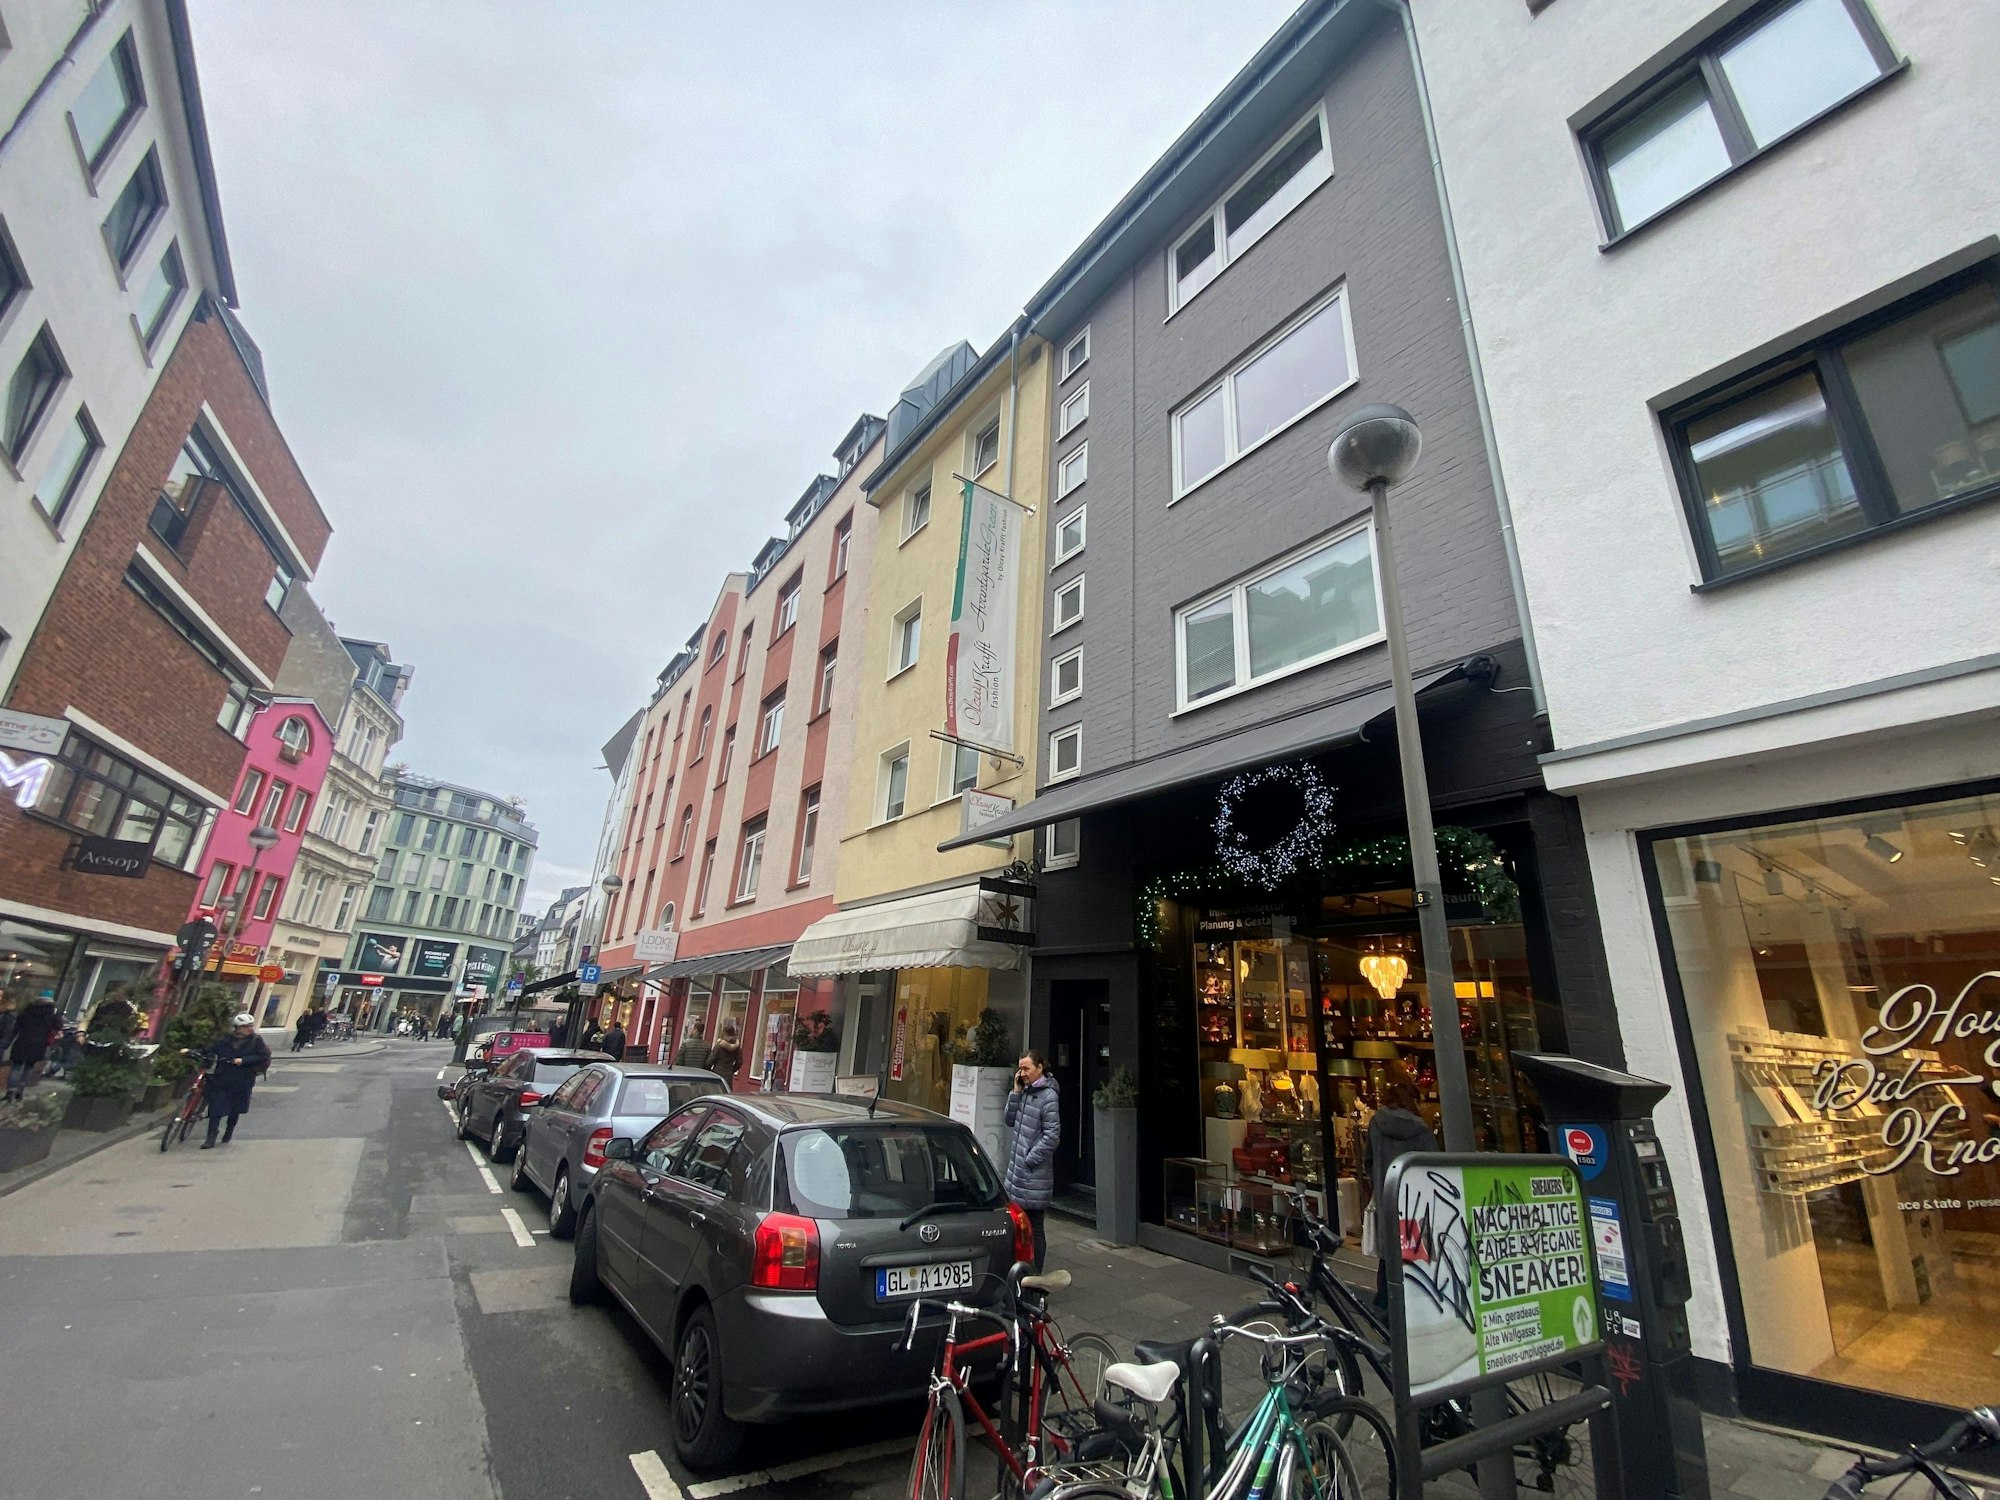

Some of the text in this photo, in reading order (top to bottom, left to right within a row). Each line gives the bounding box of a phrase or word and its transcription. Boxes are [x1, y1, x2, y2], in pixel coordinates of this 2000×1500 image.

[999, 533, 1007, 552] Krafft
[998, 553, 1006, 572] Olcay
[990, 677, 999, 709] fashion
[80, 852, 140, 872] Aesop
[1416, 892, 1424, 903] 6
[1200, 915, 1298, 931] Planung & Gestag
[1811, 1058, 1985, 1110] Did
[1578, 1156, 1596, 1164] 1503
[1532, 1178, 1563, 1196] SNEAKERS
[1897, 1201, 1921, 1211] ace
[1922, 1200, 1933, 1210] &
[1933, 1198, 1962, 1210] tate
[1472, 1202, 1579, 1234] NACHHALTIGE
[1476, 1238, 1517, 1262] FAIRE
[1520, 1237, 1530, 1256] &
[1530, 1229, 1583, 1255] VEGANE
[888, 1264, 971, 1292] GL A 1985
[1480, 1255, 1587, 1302] SNEAKER!
[1482, 1306, 1540, 1328] 2 Min. geradeaus
[1484, 1325, 1542, 1348] Alte Wallgasse 5
[1486, 1339, 1564, 1370] sneakers-unplugged.de
